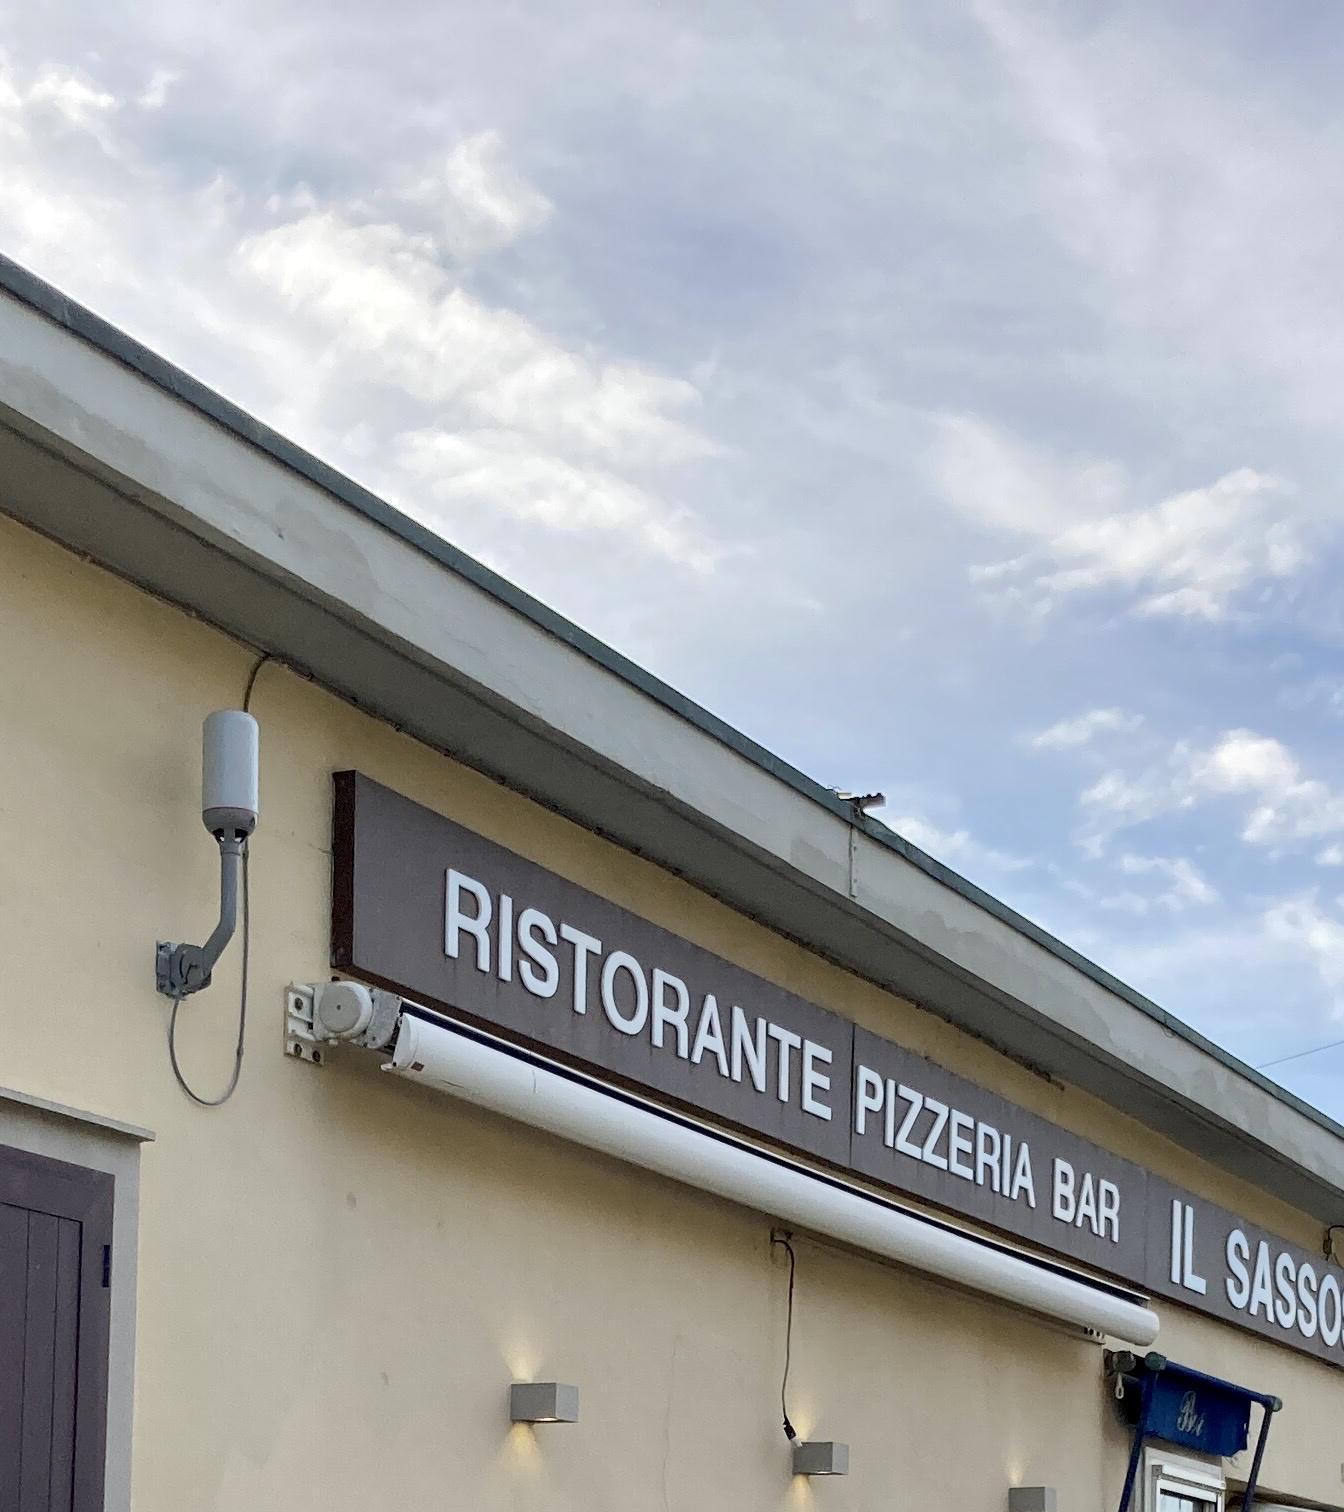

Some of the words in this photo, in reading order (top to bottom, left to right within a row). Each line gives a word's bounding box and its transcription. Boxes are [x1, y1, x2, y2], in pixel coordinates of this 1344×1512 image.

[444, 867, 834, 1122] RISTORANTE
[855, 1063, 1037, 1209] PIZZERIA
[1052, 1156, 1122, 1244] BAR
[1170, 1198, 1208, 1296] IL
